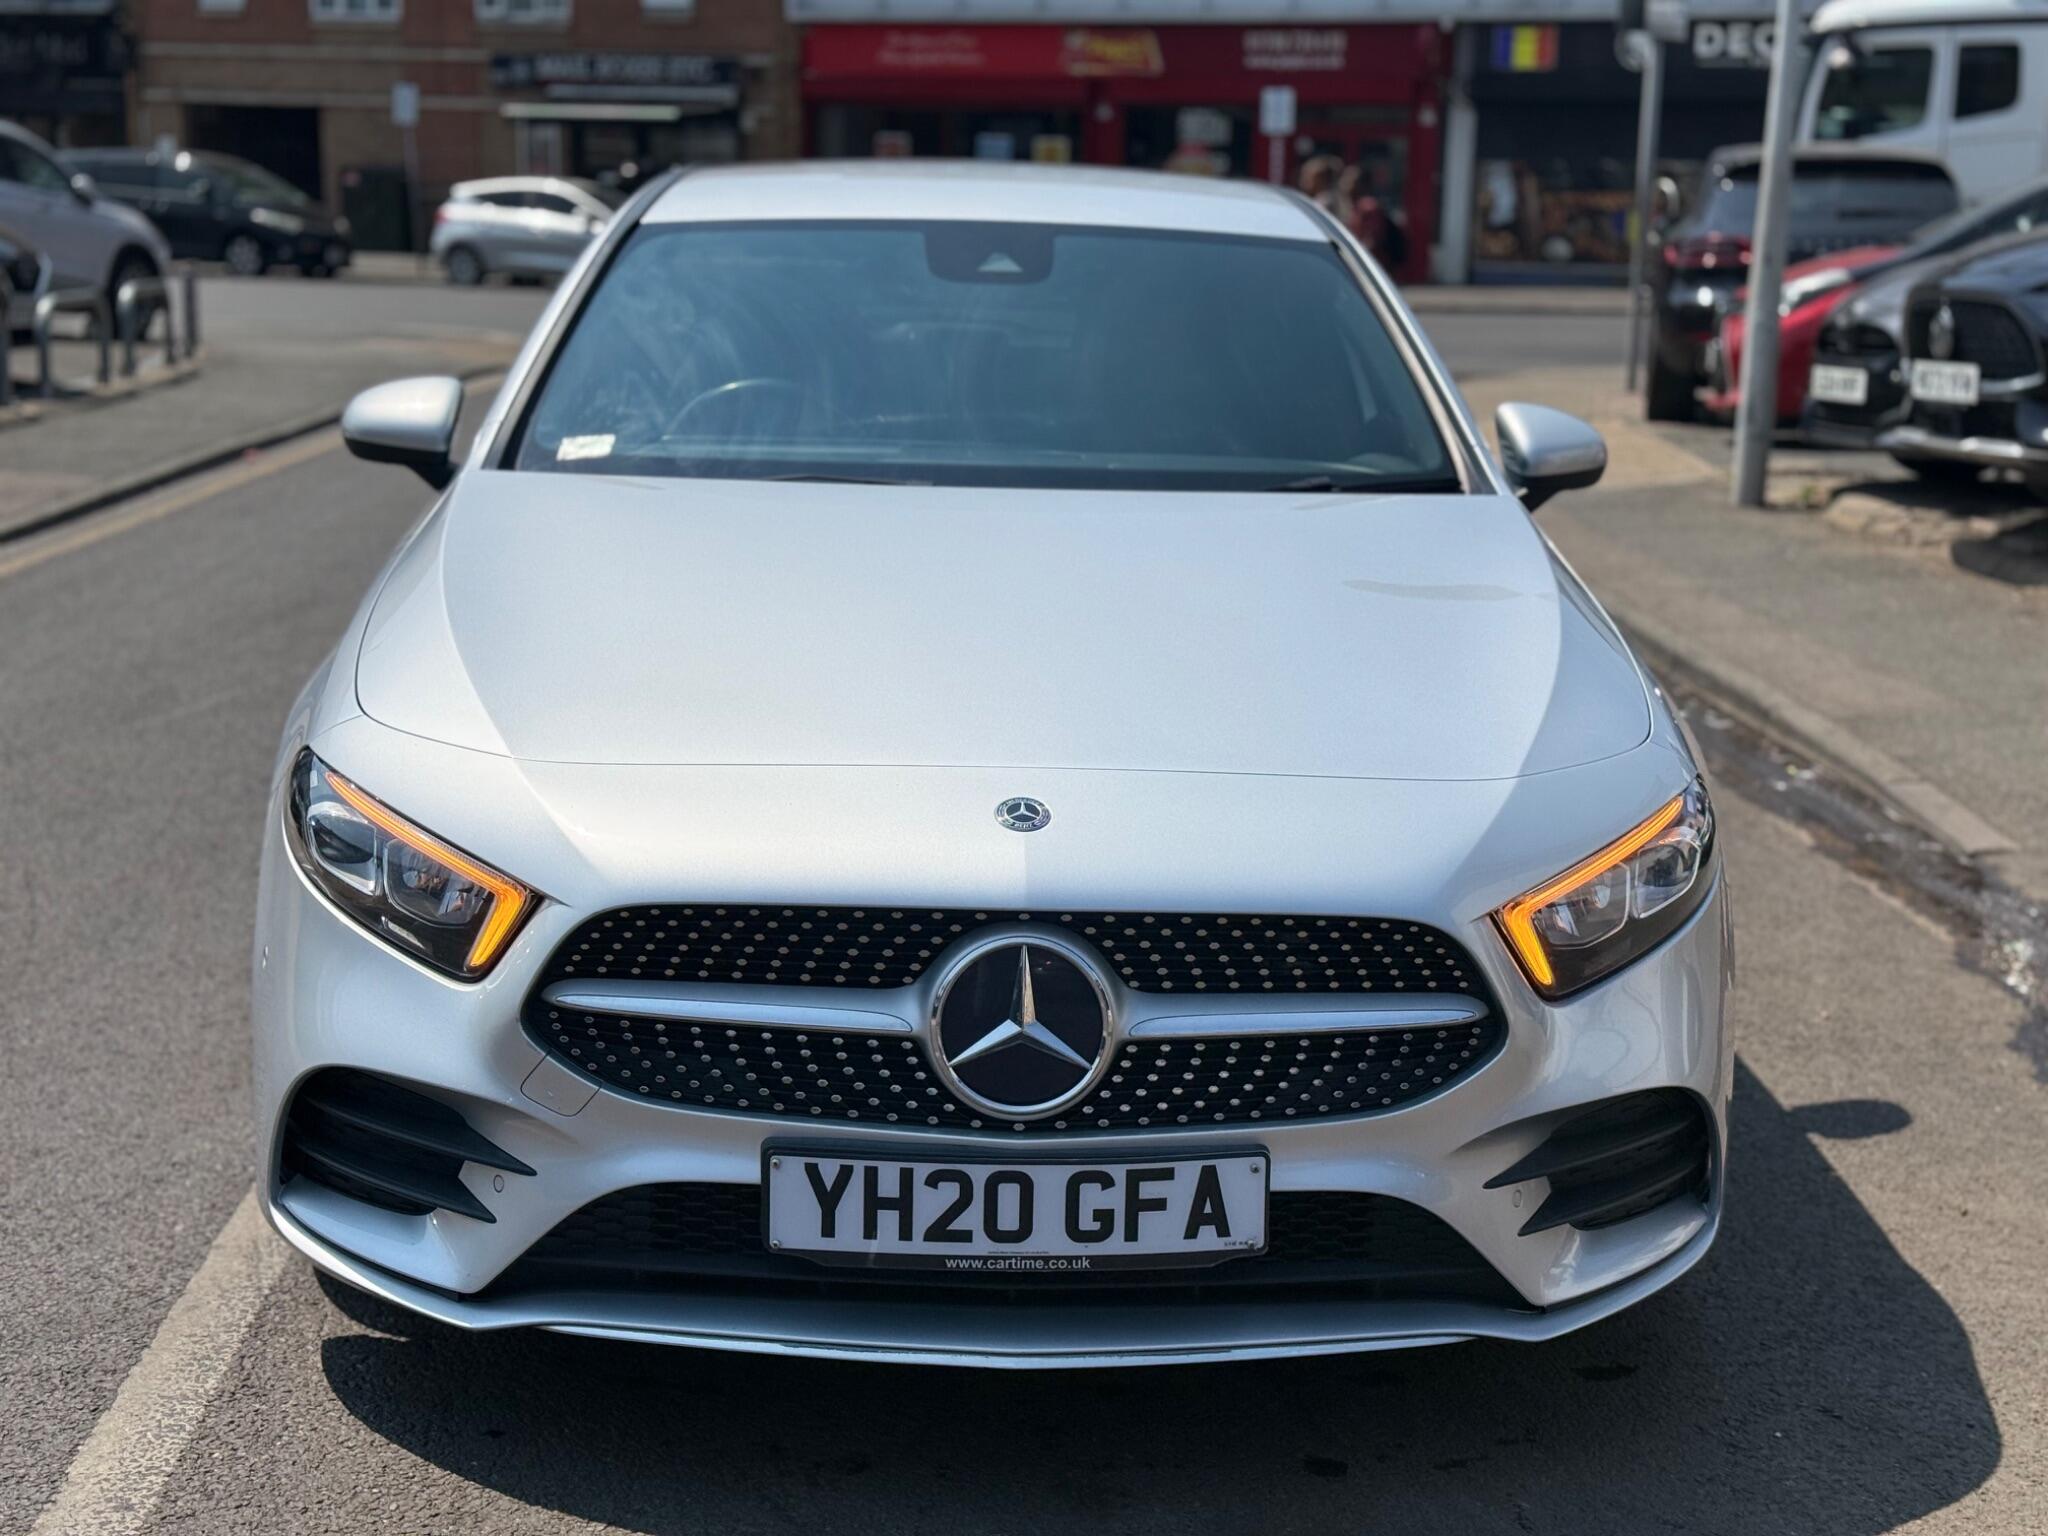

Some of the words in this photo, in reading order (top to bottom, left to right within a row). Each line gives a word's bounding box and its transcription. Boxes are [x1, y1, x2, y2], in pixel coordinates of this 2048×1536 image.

[804, 1162, 1034, 1244] YH20
[1065, 1164, 1232, 1244] GFA
[944, 1256, 1091, 1270] www.cartime.co.uk
